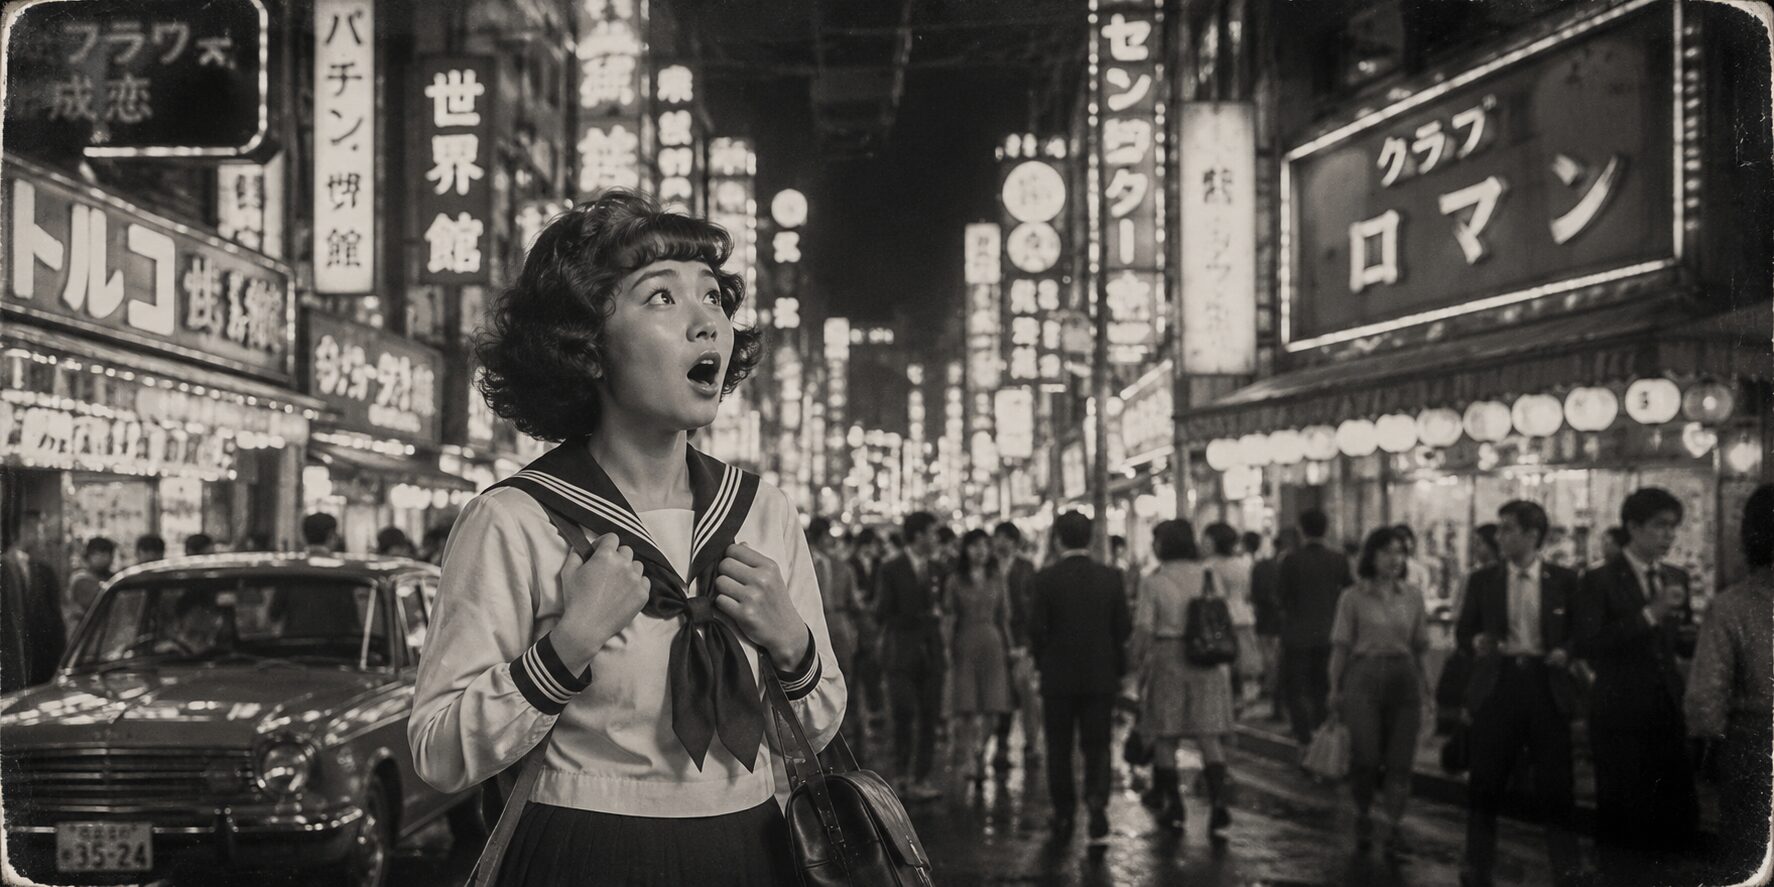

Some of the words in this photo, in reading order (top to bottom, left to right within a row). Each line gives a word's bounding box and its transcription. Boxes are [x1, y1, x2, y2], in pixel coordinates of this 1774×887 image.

[424, 69, 485, 273] 世界館
[1377, 94, 1497, 187] クラブ
[13, 178, 176, 336] トルコ
[1350, 155, 1618, 293] ロマン
